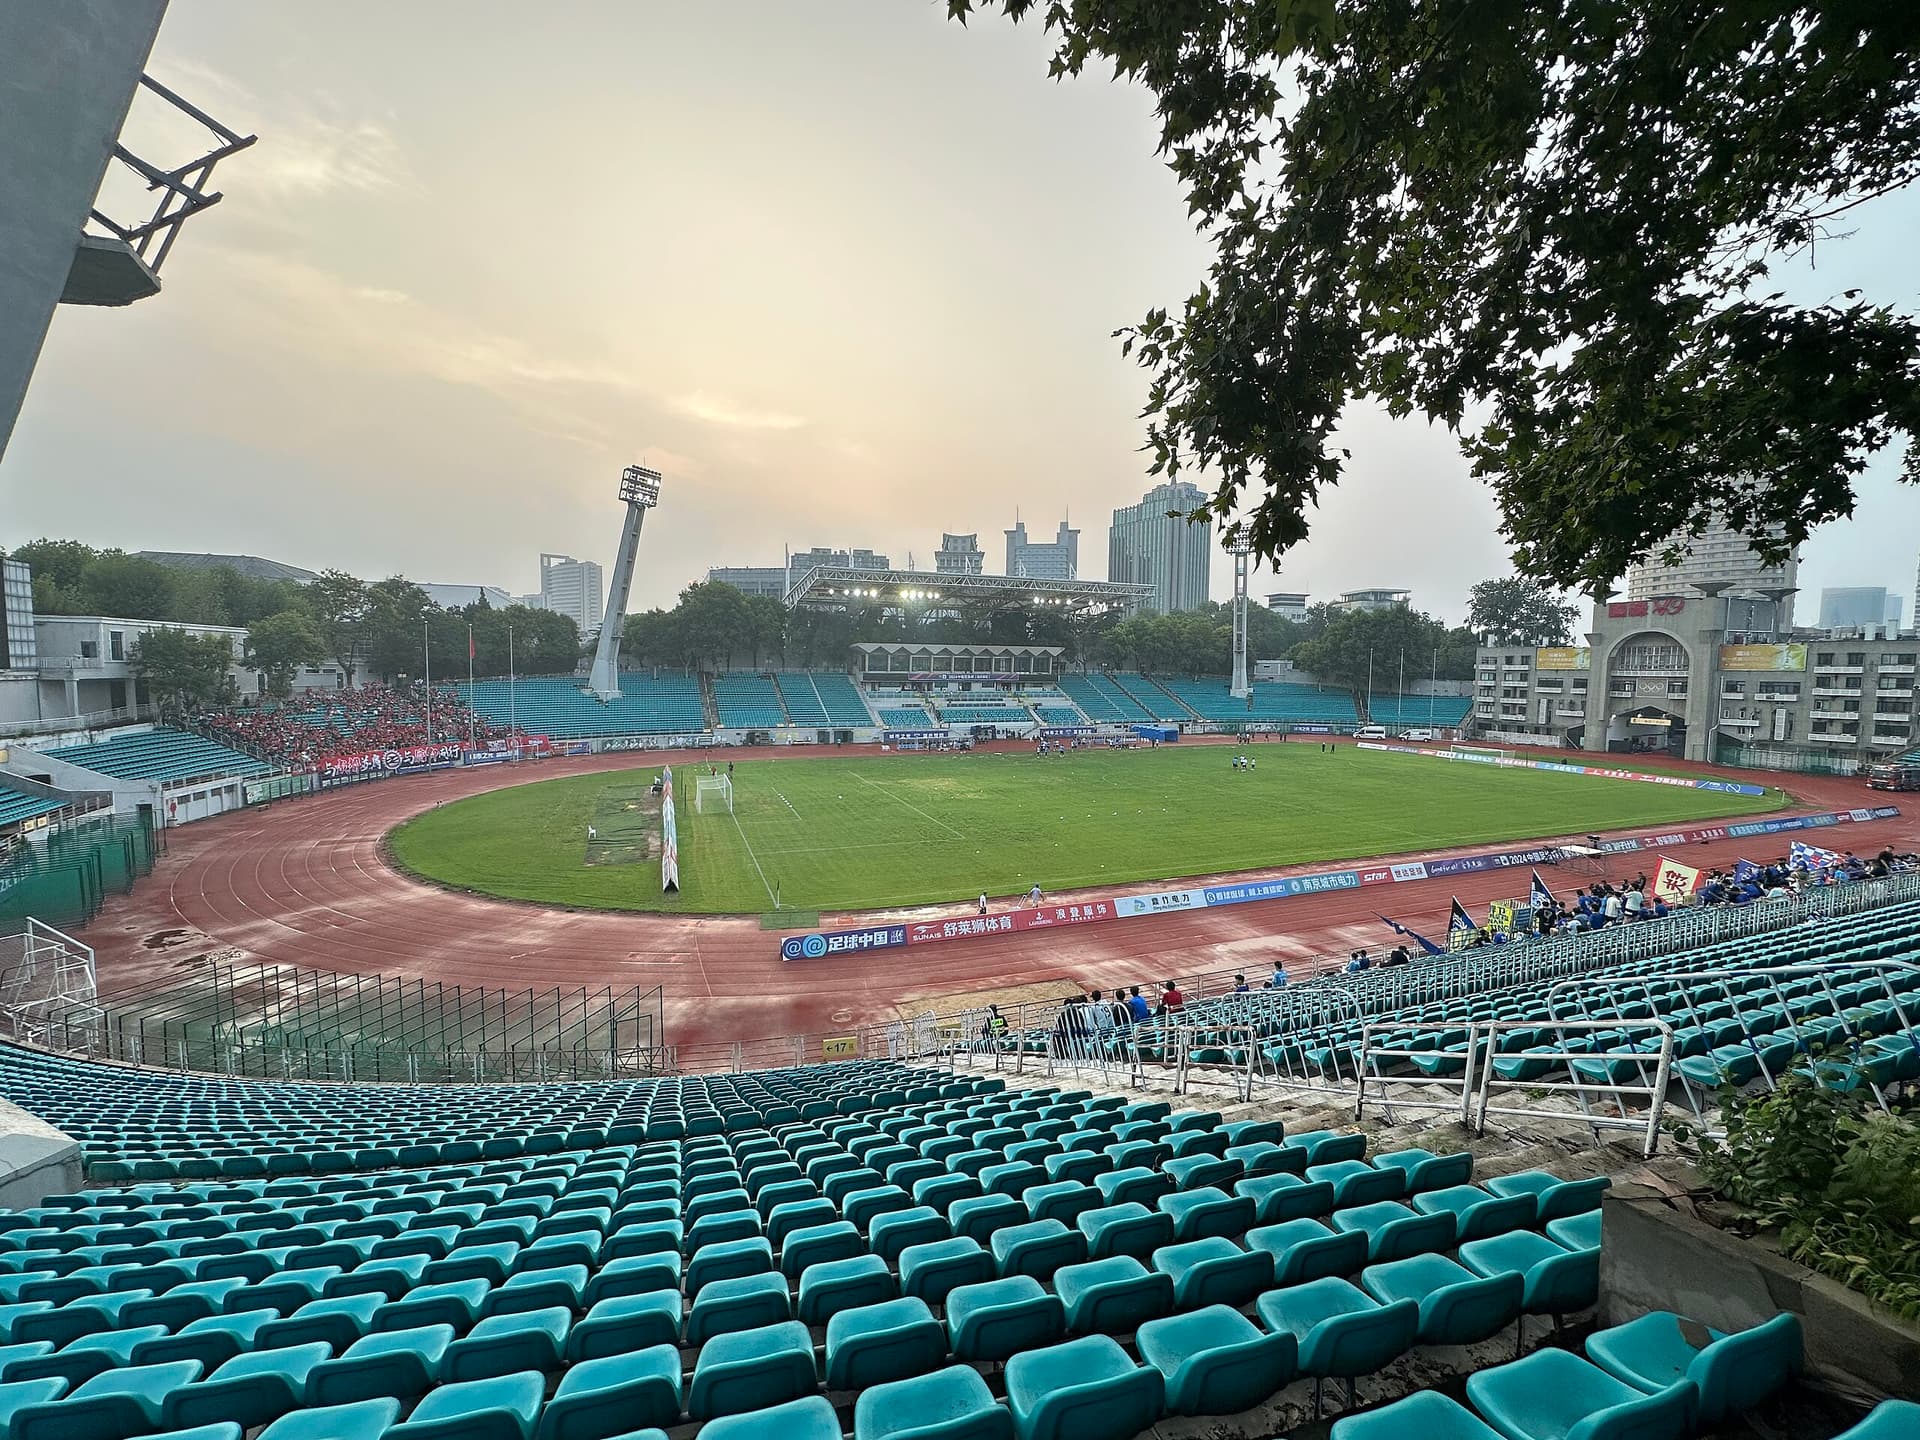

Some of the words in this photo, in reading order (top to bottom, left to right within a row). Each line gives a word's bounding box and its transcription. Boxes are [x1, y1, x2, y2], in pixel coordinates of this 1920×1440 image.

[943, 915, 1013, 938] 舒莱狮体育
[828, 930, 888, 953] 足球中国
[912, 932, 942, 942] SUNAIS
[834, 1043, 847, 1053] 17
